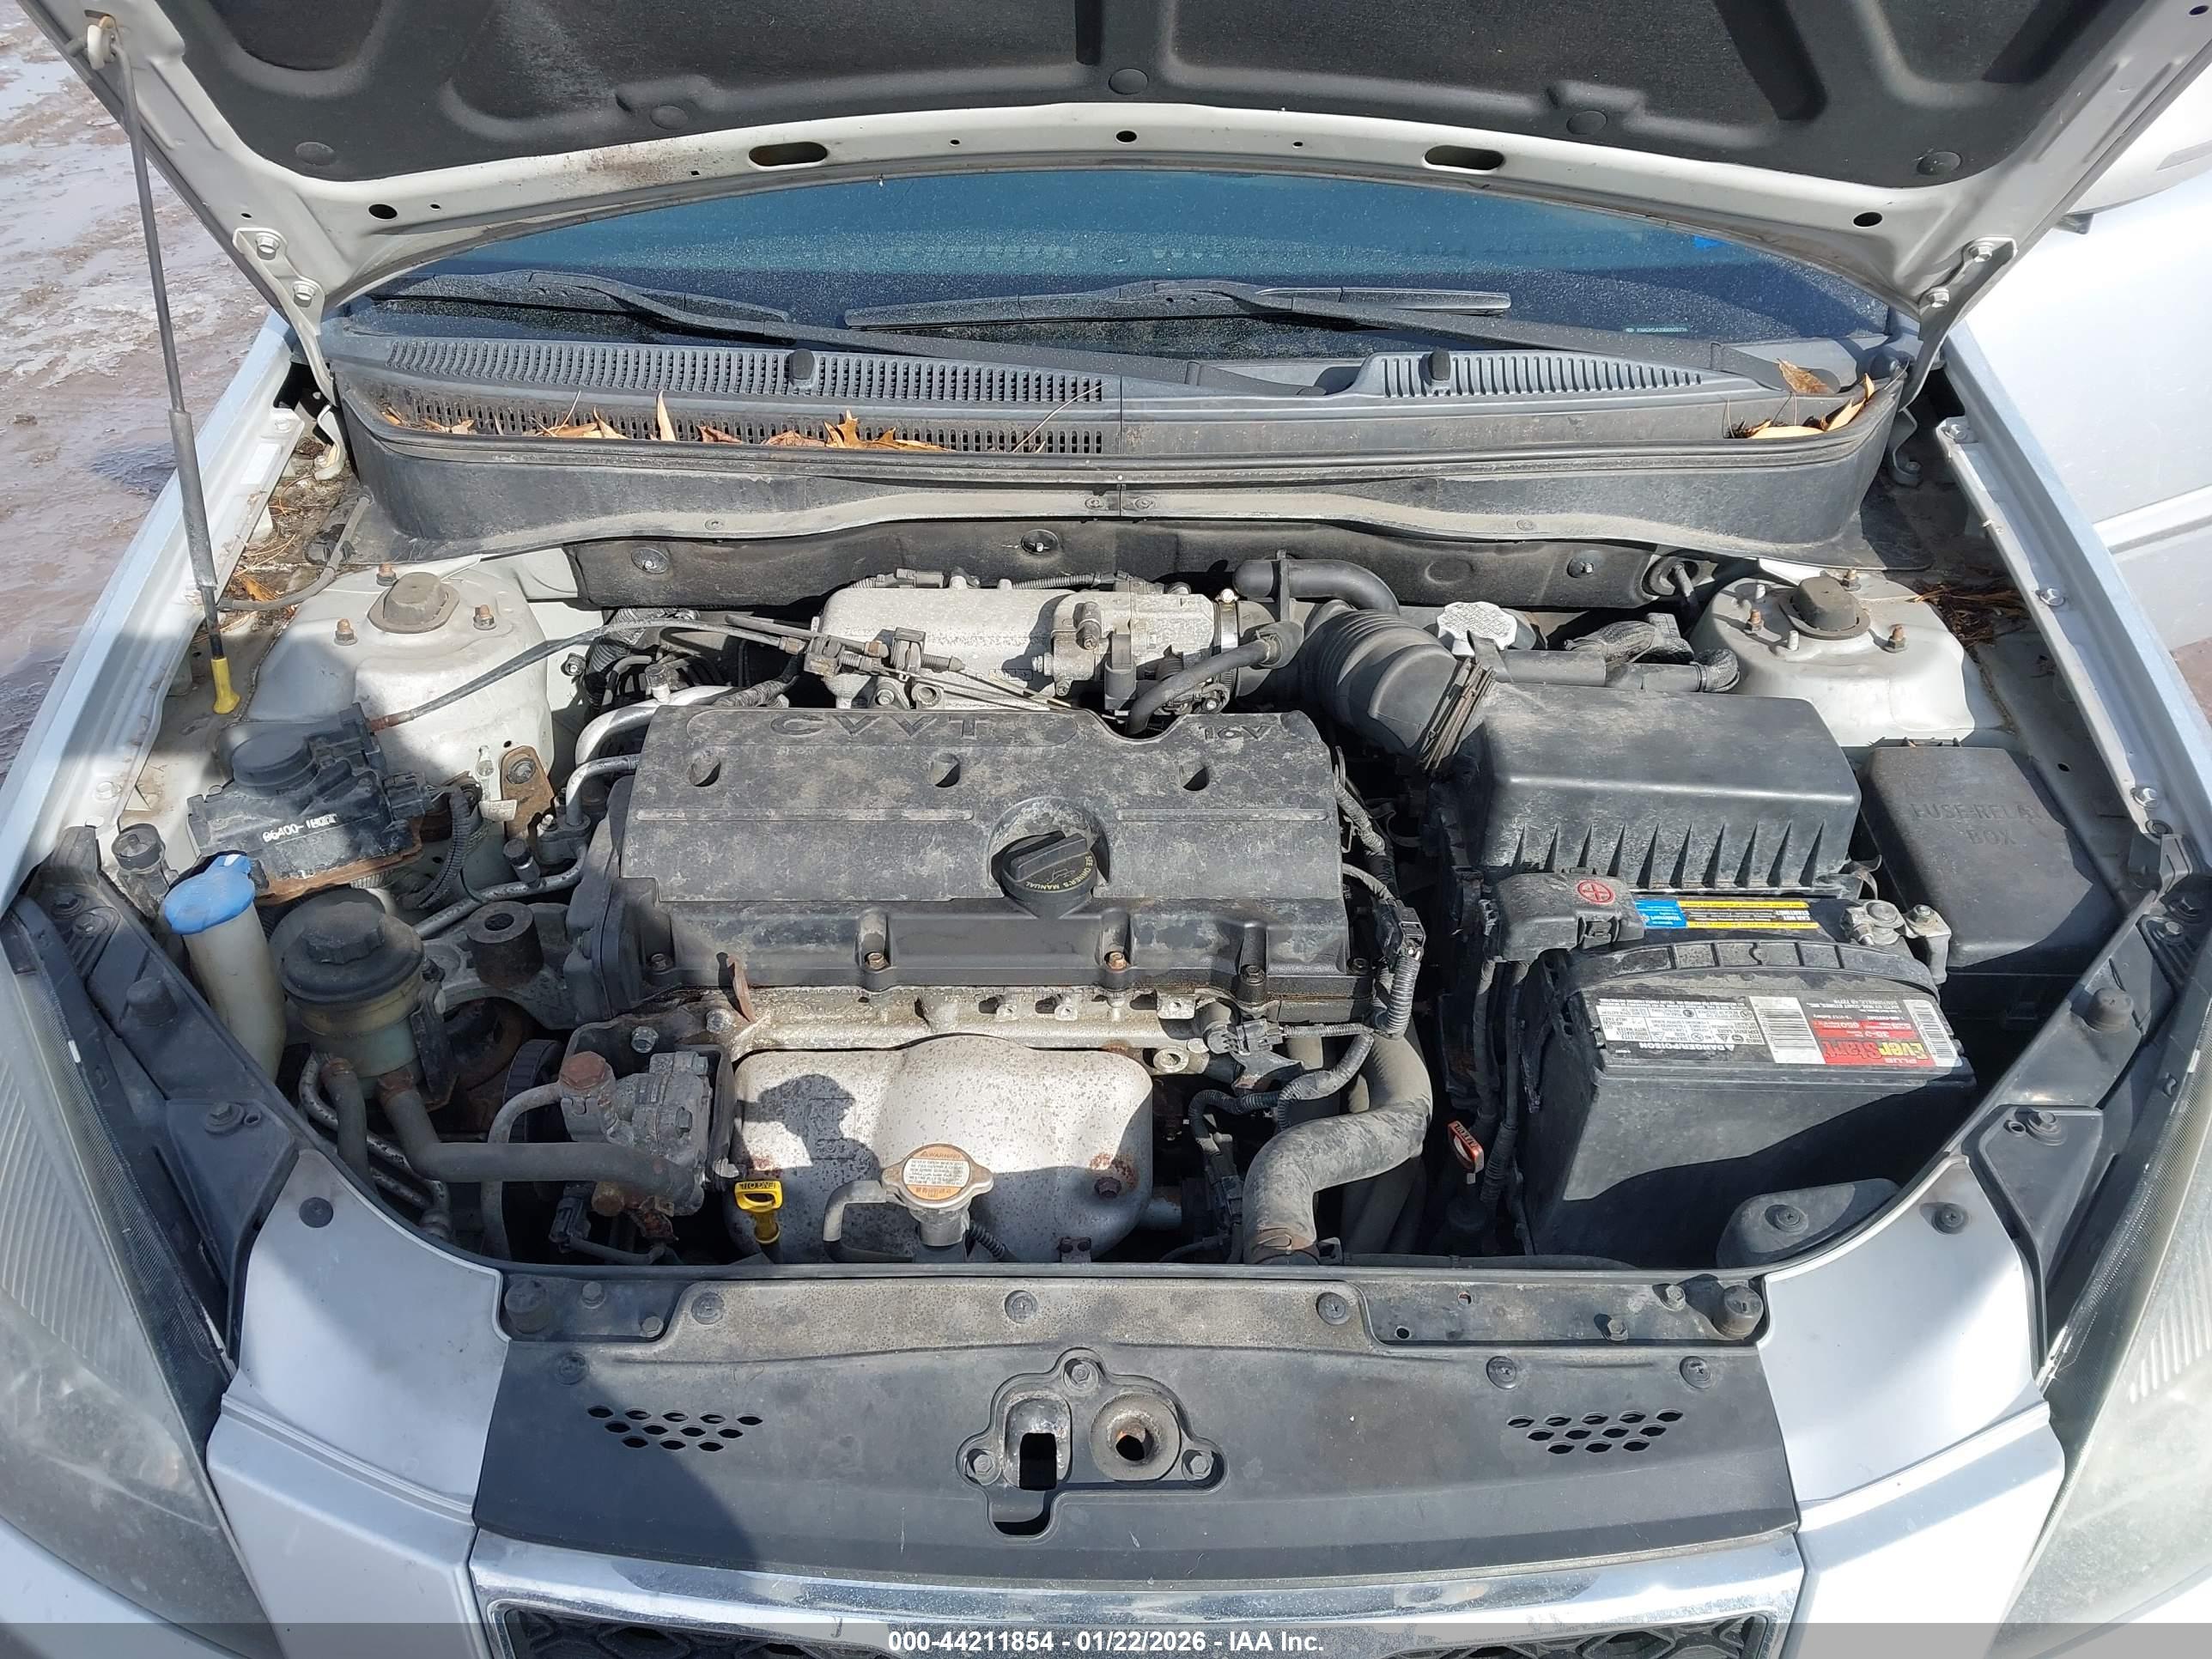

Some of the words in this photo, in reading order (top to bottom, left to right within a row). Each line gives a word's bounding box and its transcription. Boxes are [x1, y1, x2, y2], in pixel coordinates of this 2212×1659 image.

[769, 714, 990, 740] CVVT
[1198, 724, 1272, 741] 16V
[1965, 830, 2019, 846] BOX
[1024, 880, 1060, 890] MANUAL
[1639, 1042, 1726, 1051] DANGER/POISON
